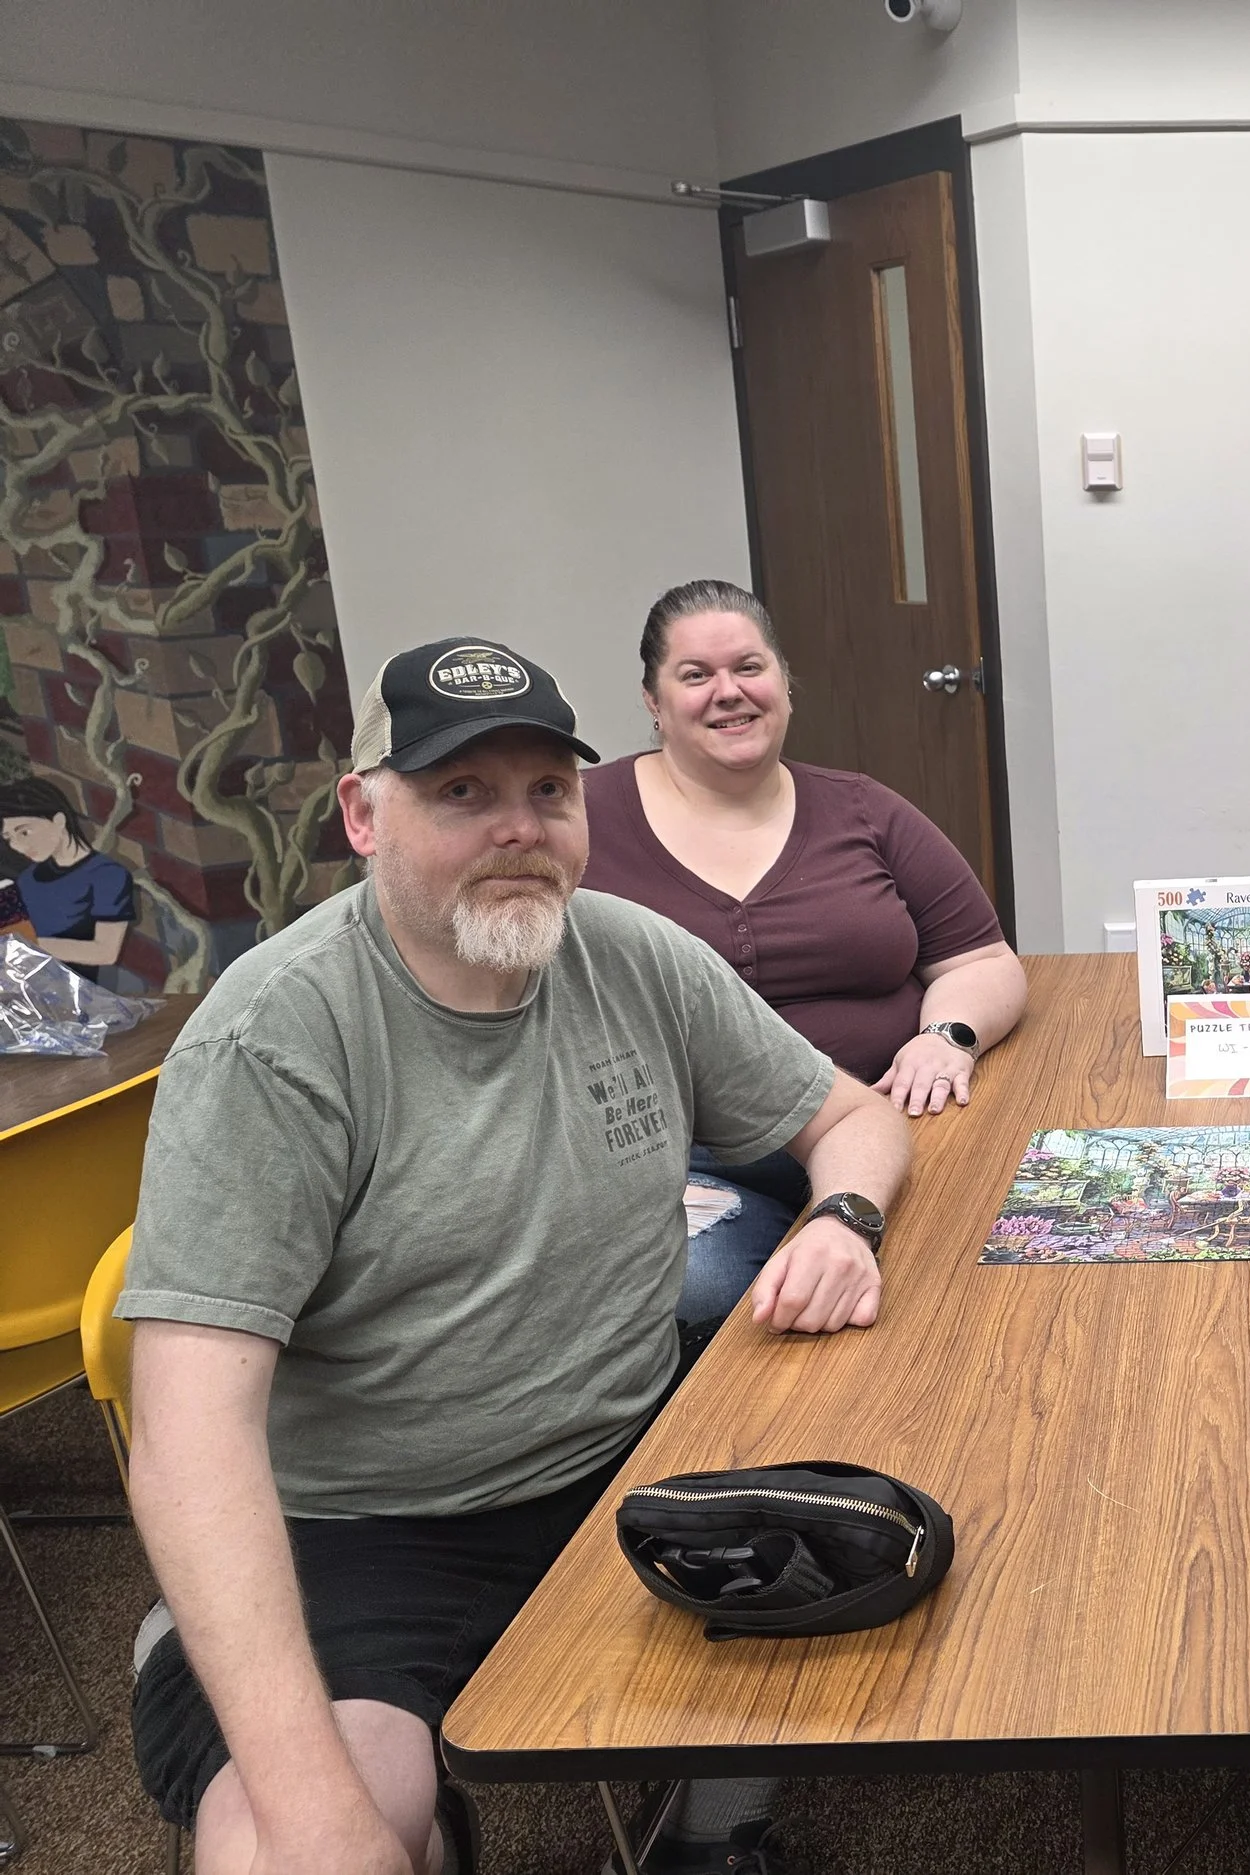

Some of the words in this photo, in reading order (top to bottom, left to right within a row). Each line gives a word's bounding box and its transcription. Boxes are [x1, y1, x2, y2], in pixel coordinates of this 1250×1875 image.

[437, 663, 522, 682] EDLEY'S
[454, 674, 515, 685] BAR-B-QUE
[1156, 891, 1183, 907] 500
[1190, 1023, 1233, 1033] PUZZLE
[587, 1073, 629, 1105] We'll
[633, 1063, 654, 1090] All
[605, 1106, 622, 1125] Be
[626, 1092, 658, 1117] Here
[604, 1108, 668, 1152] FOREVER
